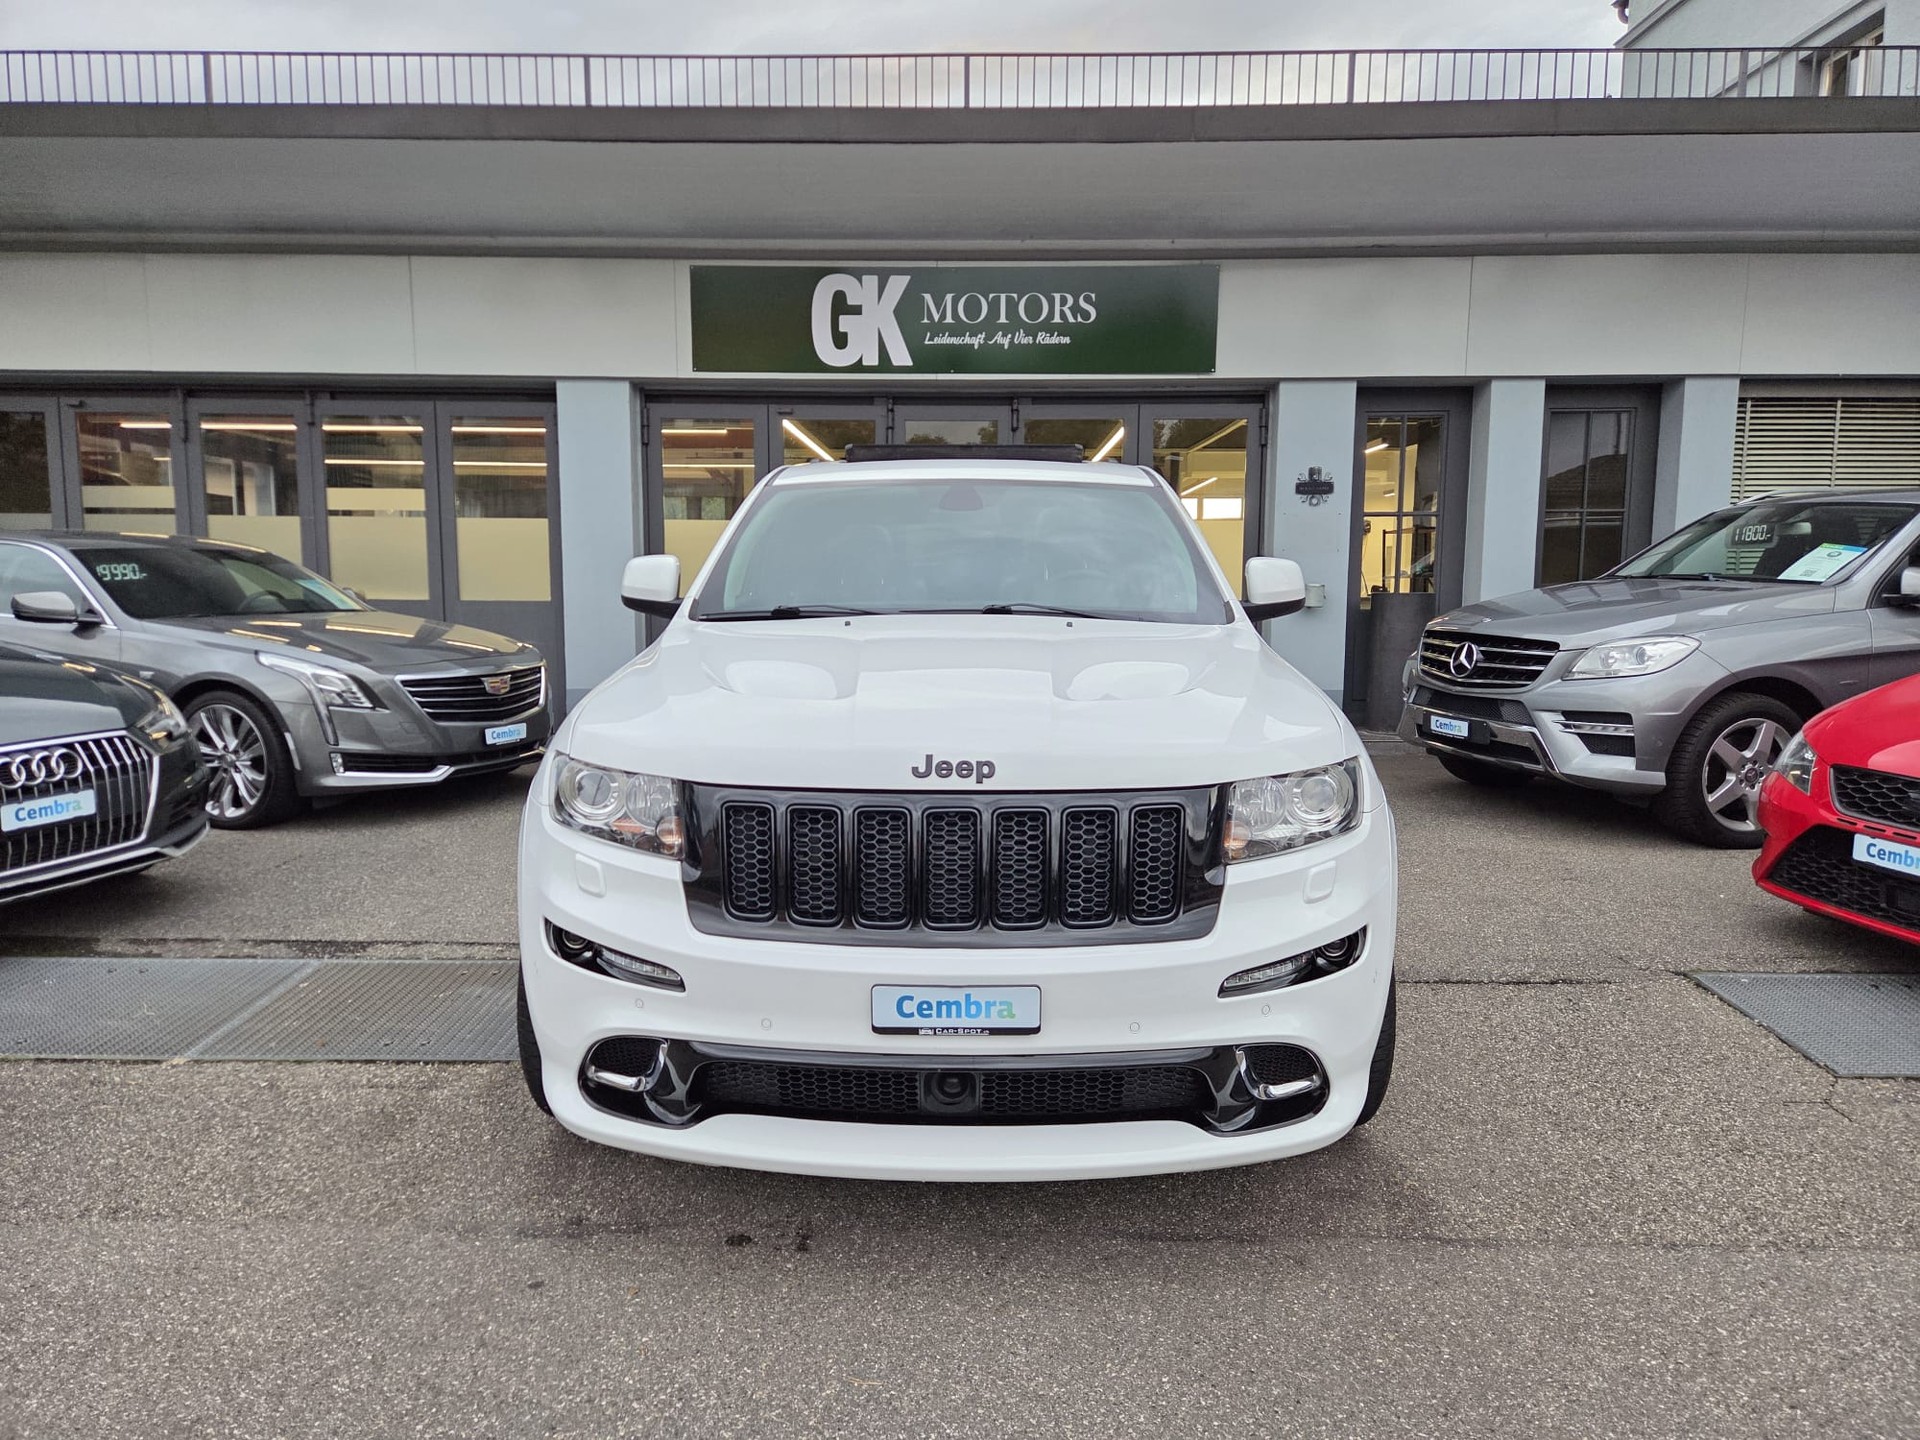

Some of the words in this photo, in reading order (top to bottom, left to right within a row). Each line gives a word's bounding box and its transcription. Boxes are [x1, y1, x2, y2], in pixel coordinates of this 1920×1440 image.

[811, 273, 914, 367] GK
[920, 292, 1097, 324] MOTORS
[924, 331, 986, 350] Leidenschaft
[987, 330, 1013, 350] Auf
[1013, 328, 1034, 345] Vier
[1036, 331, 1071, 345] Rädern
[491, 728, 521, 740] Cembra
[1435, 719, 1462, 733] Cembra
[911, 754, 996, 784] Jeep
[14, 799, 82, 822] Cembra
[896, 993, 1016, 1020] Cembra
